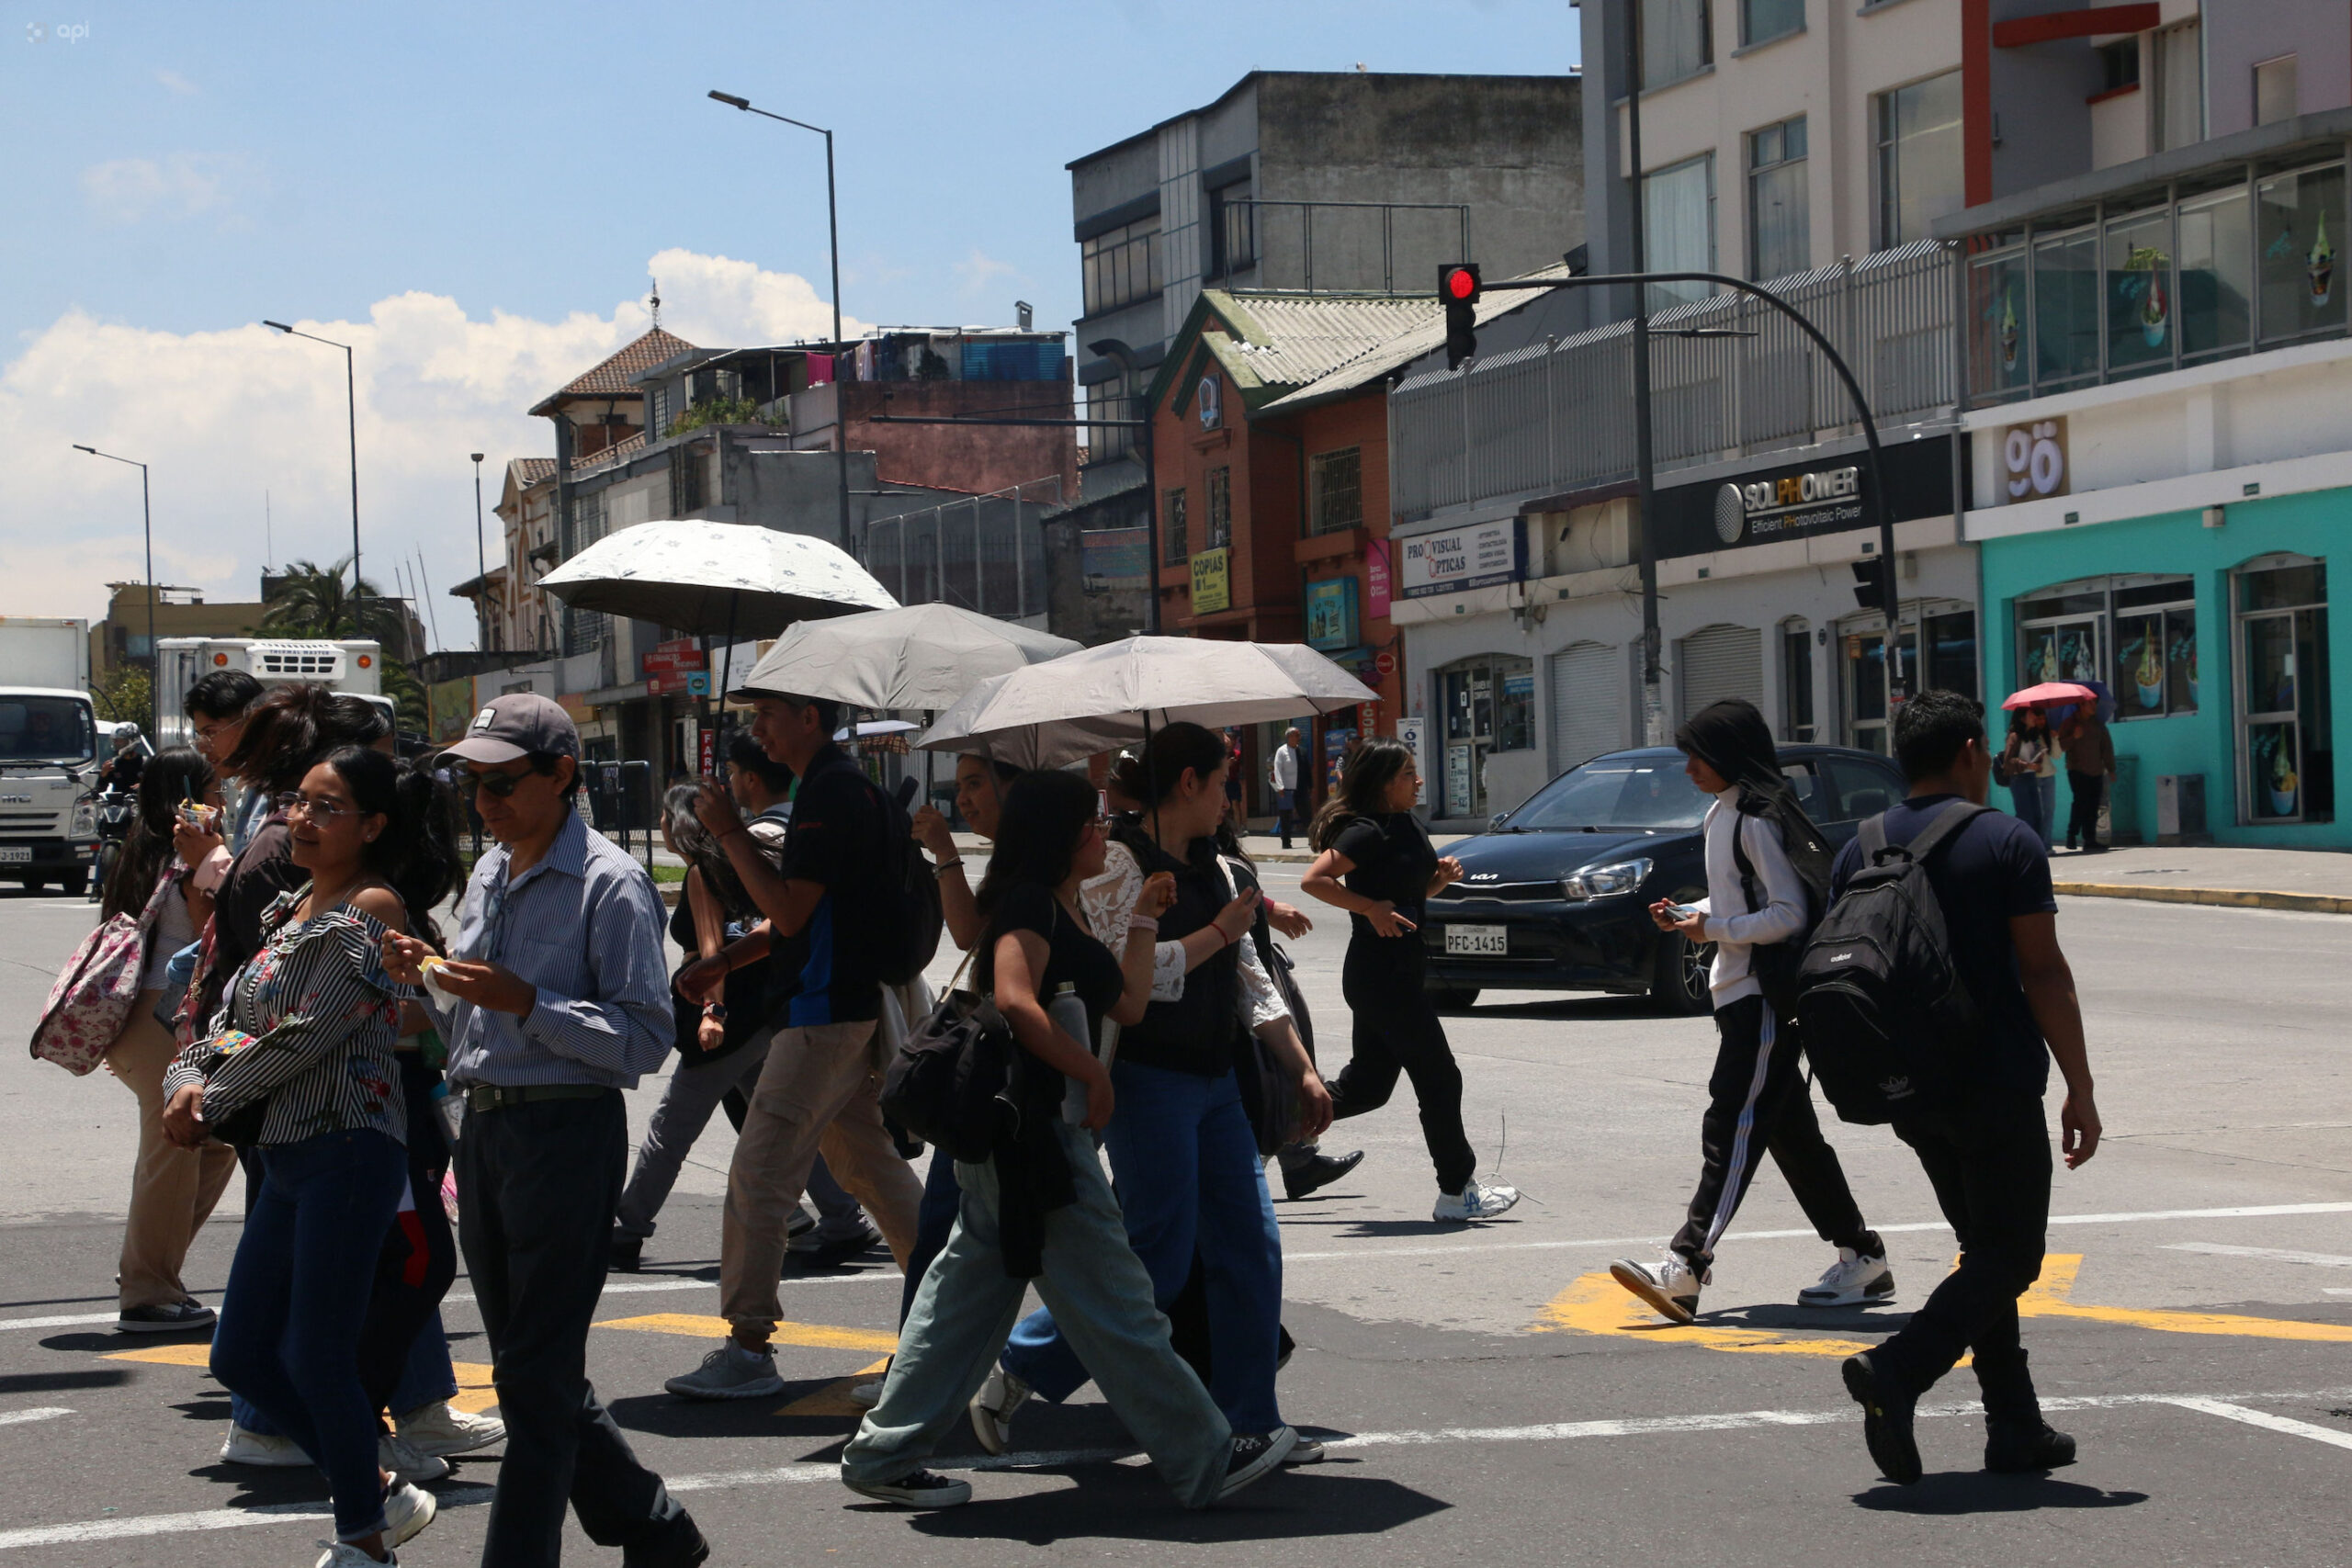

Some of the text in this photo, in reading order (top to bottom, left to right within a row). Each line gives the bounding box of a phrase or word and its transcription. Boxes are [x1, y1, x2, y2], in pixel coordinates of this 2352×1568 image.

[1746, 466, 1860, 512] SOLPHOWER
[1751, 504, 1862, 535] Efficient PHotovoltaic Power
[1408, 536, 1463, 559] PRO VISUAL
[1193, 556, 1224, 577] COPIAS
[1429, 556, 1466, 579] OPTICAS
[0, 852, 30, 861] J-1921
[1448, 935, 1505, 952] PFC-1415
[1463, 1187, 1483, 1213] LA
